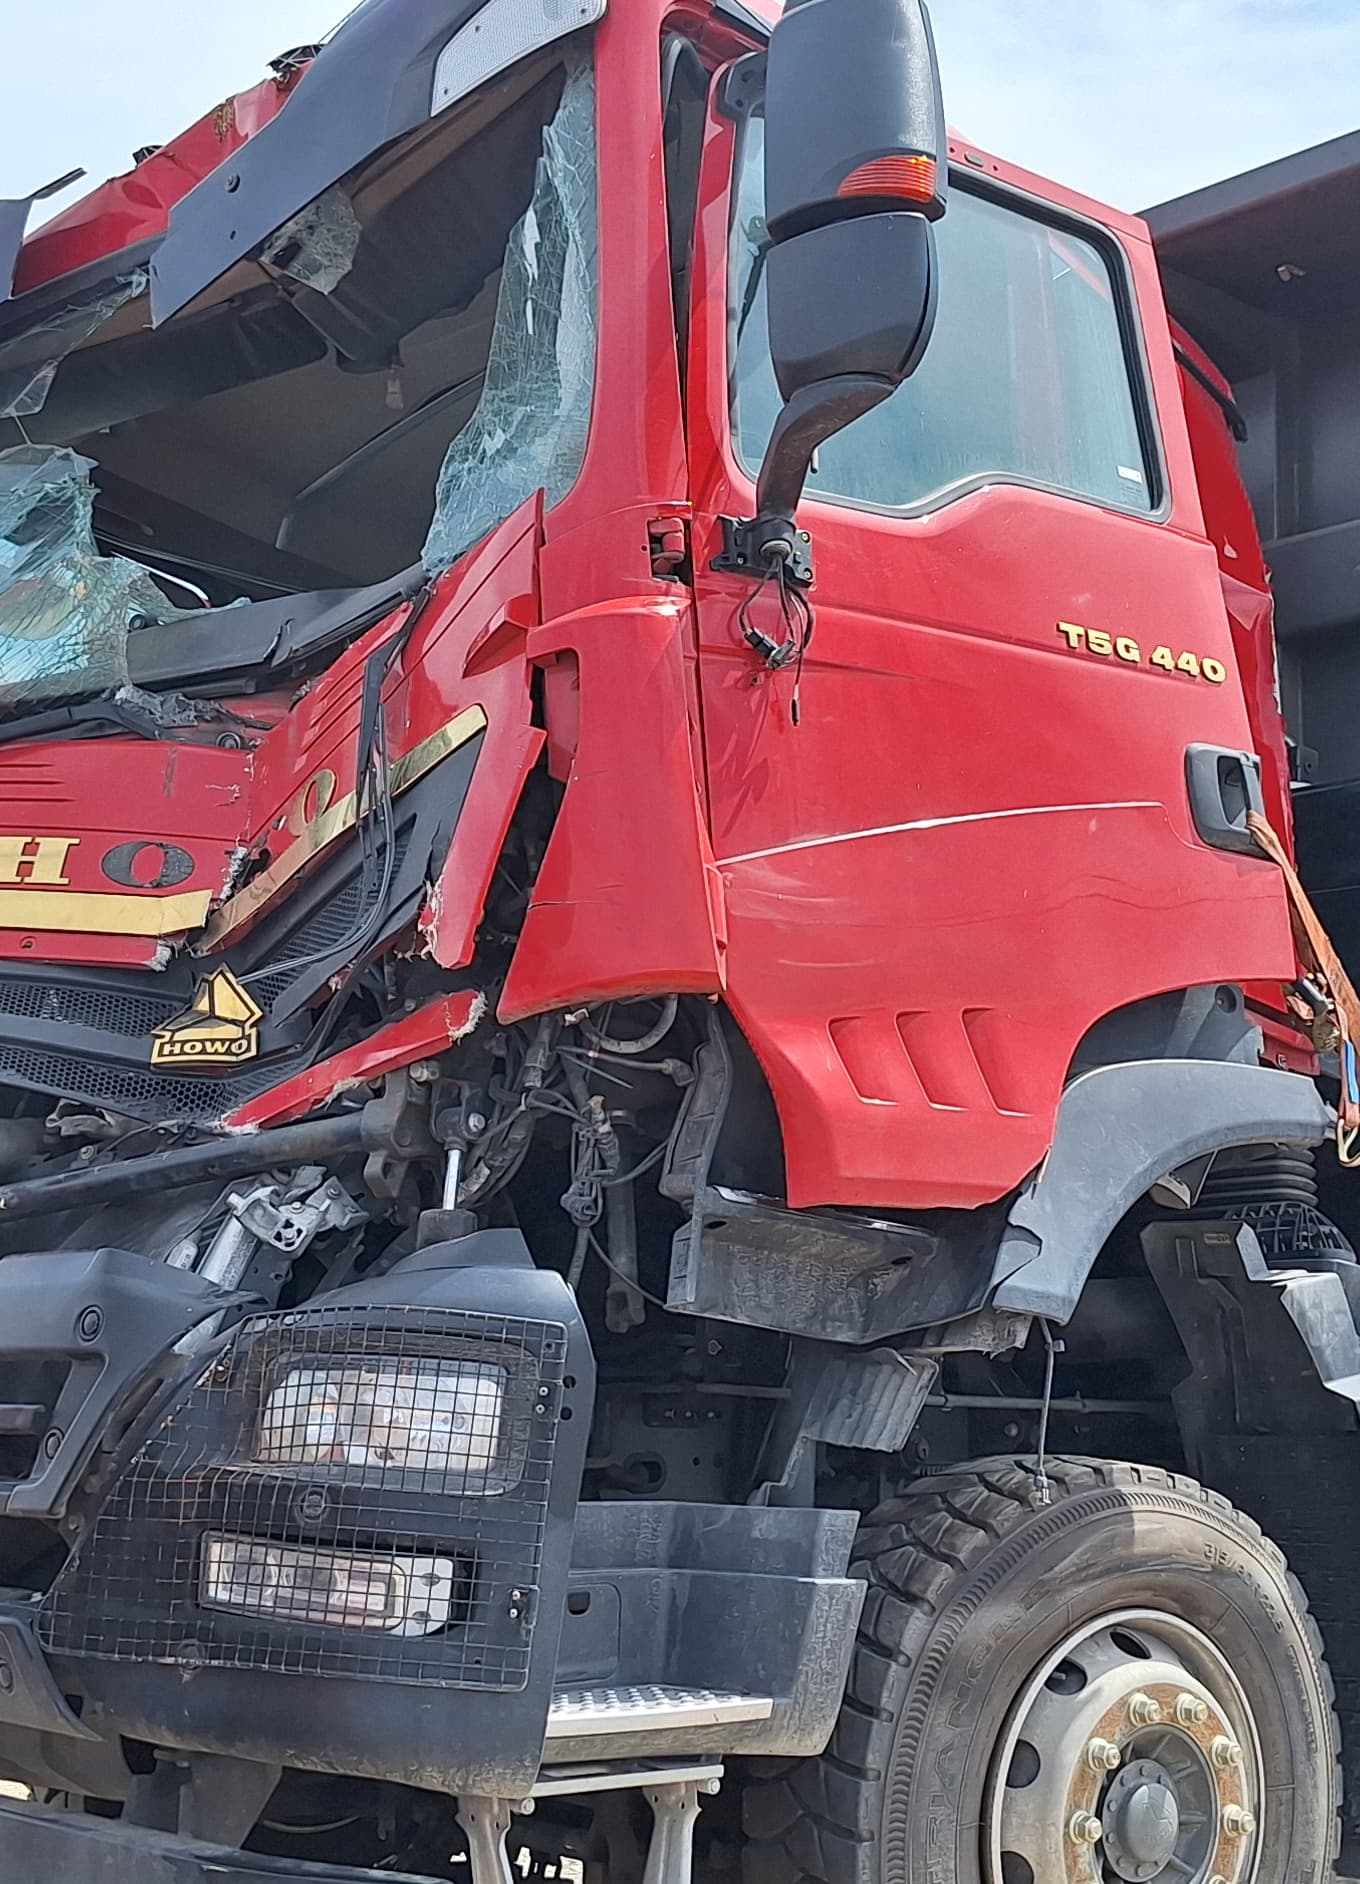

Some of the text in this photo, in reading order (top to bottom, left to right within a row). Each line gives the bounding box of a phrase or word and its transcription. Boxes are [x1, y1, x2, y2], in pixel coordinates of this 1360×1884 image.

[1056, 621, 1227, 684] T5G 440
[162, 1038, 249, 1056] HOWO
